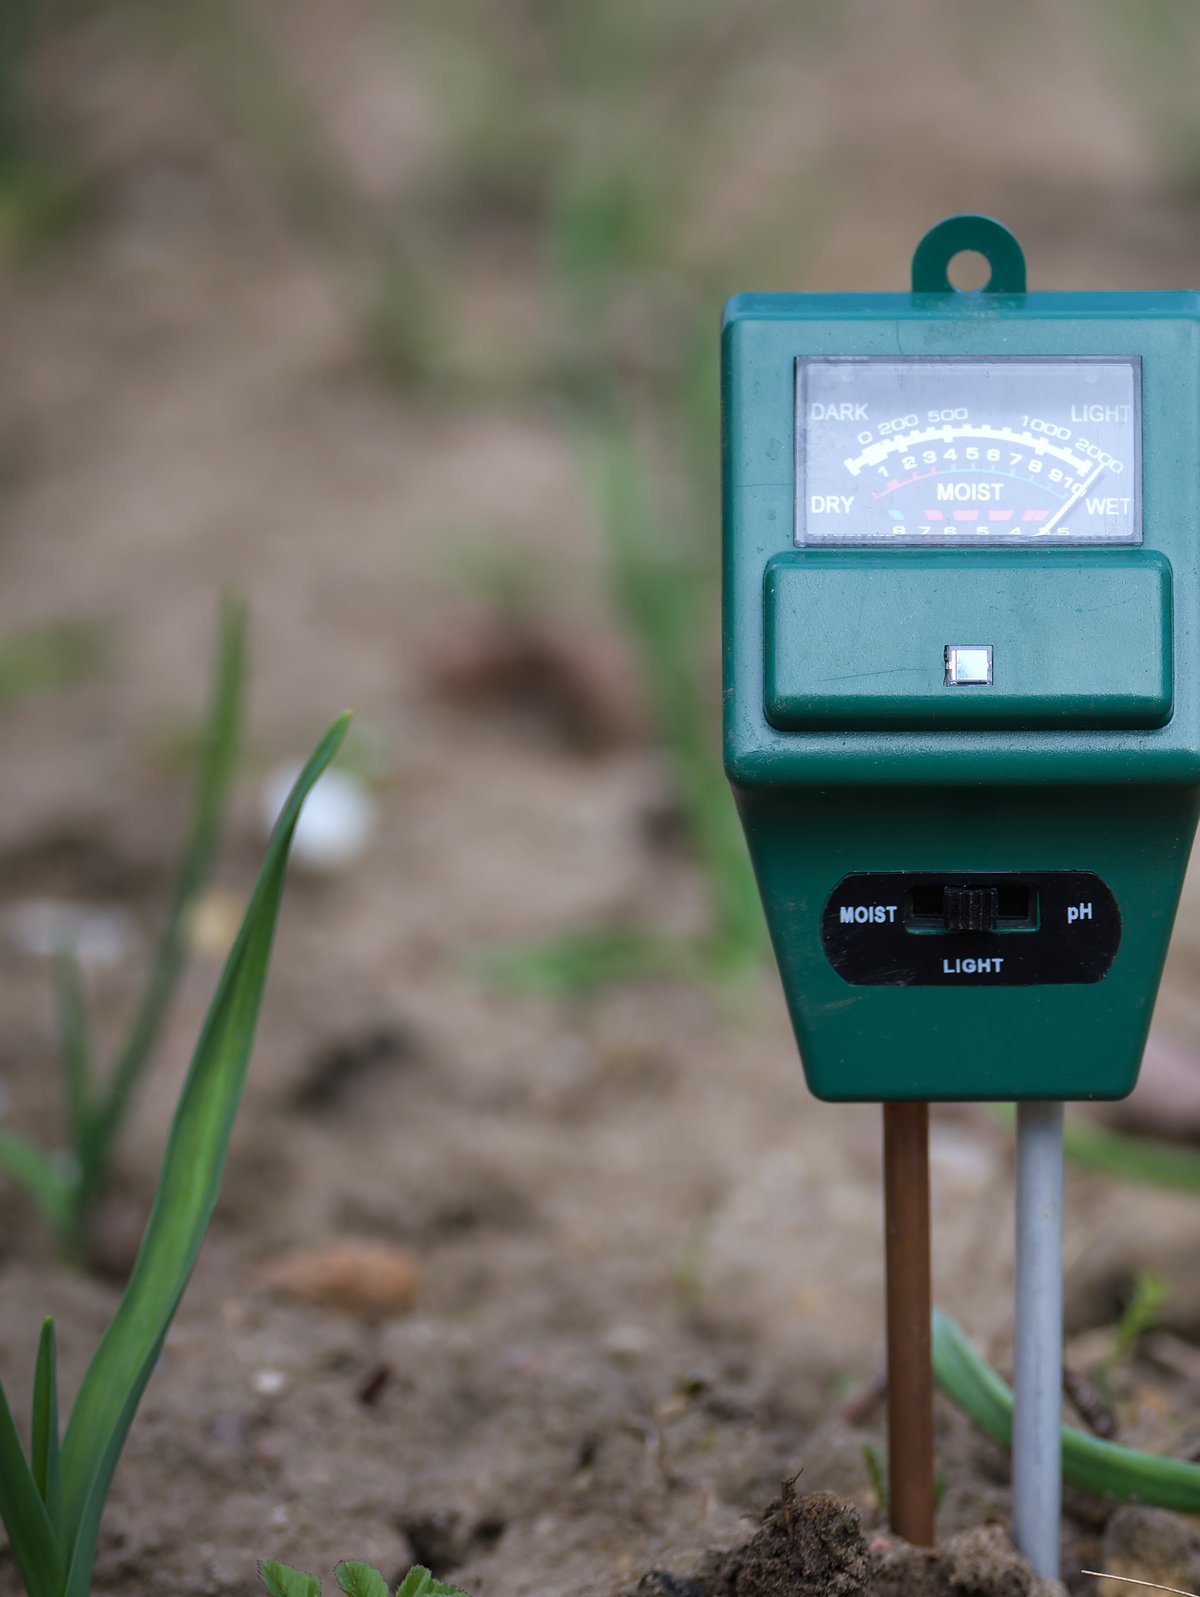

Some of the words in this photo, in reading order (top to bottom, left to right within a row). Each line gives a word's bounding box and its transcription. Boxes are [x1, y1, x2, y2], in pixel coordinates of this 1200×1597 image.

[811, 403, 869, 421] DARK
[1071, 404, 1131, 422] LIGHT
[857, 431, 873, 445] 0
[877, 414, 919, 436] 200
[928, 408, 969, 422] 500
[1021, 415, 1072, 441] 1000
[1075, 438, 1124, 474] 2000
[878, 466, 889, 478] 1
[902, 456, 917, 470] 2
[923, 451, 937, 464] 3
[943, 448, 958, 461] 4
[966, 447, 980, 460] 5
[987, 449, 1001, 462] 6
[1009, 453, 1024, 466] 7
[1028, 459, 1043, 473] 8
[1048, 468, 1064, 482] 9
[937, 483, 1005, 501] MOIST
[811, 496, 855, 513] DRY
[1085, 498, 1131, 515] WET
[840, 906, 898, 924] MOIST
[1067, 903, 1093, 923] pH
[943, 958, 1004, 974] LIGHT
